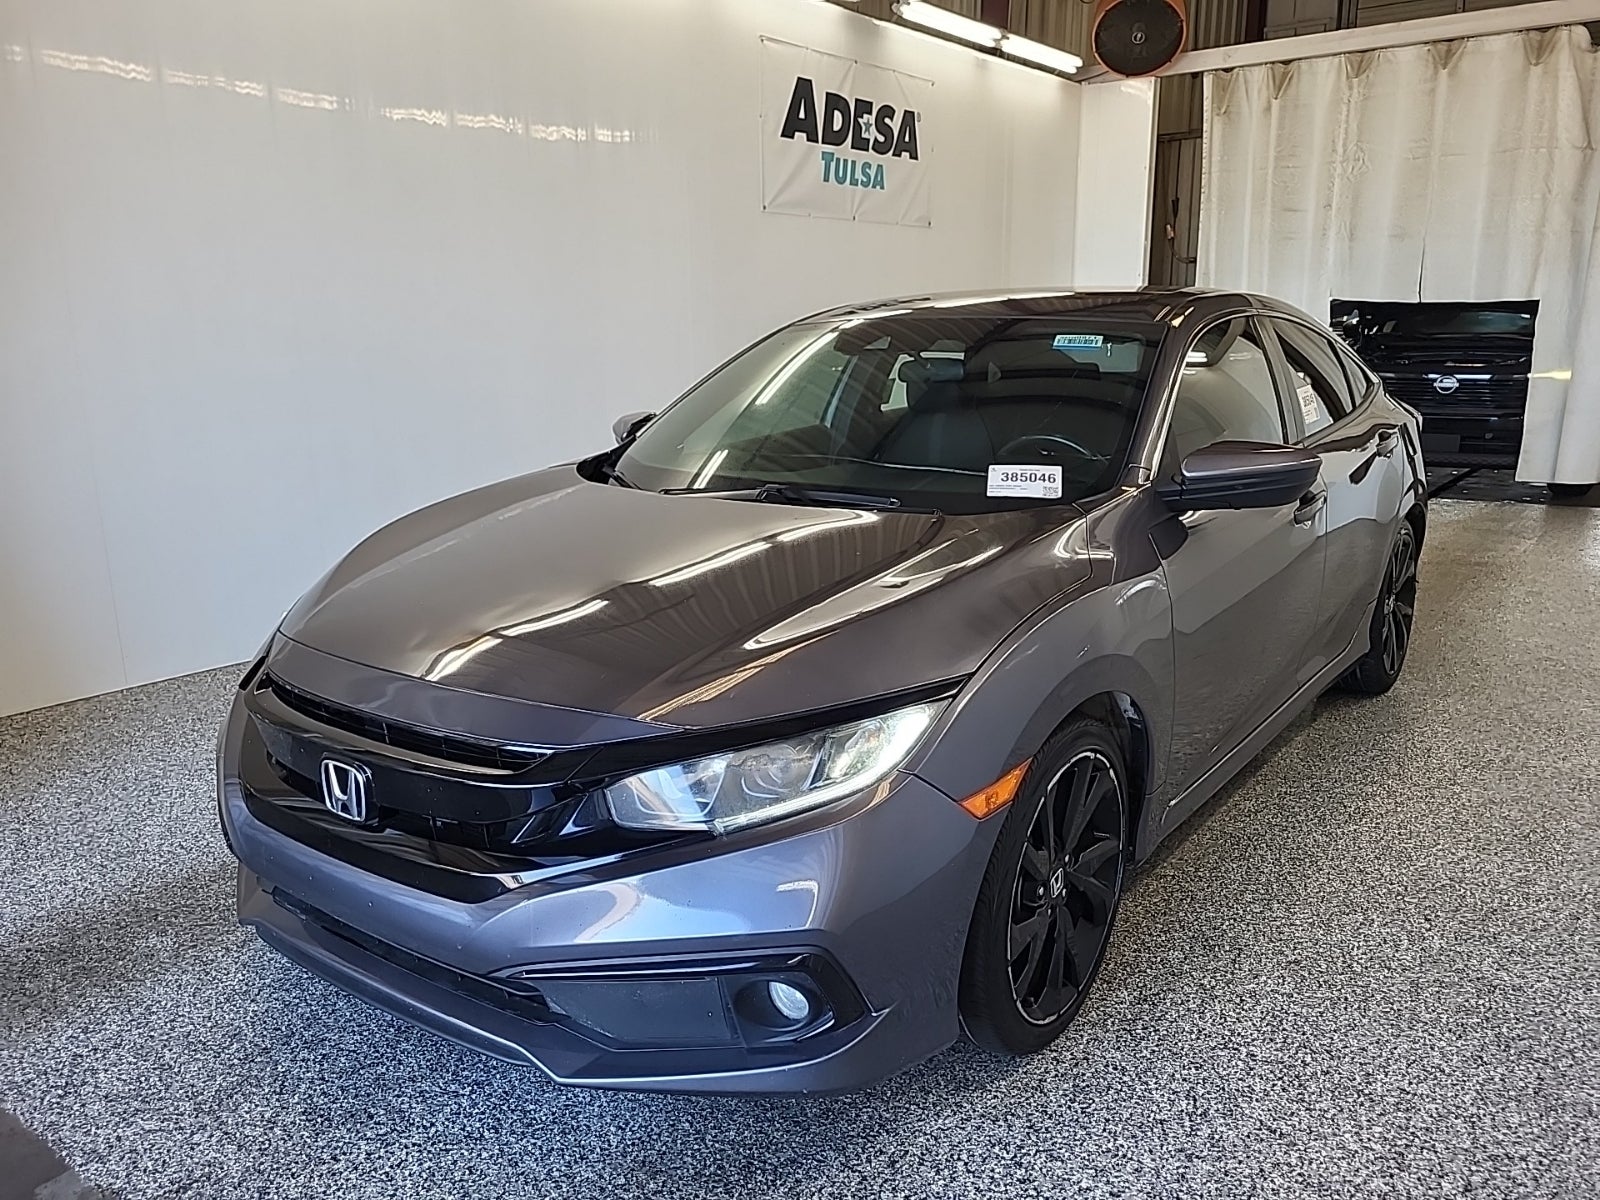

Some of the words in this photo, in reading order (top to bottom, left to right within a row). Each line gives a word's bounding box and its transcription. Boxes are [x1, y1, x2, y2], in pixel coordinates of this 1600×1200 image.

[780, 76, 919, 161] ADESA
[821, 150, 885, 190] TULSA
[1000, 471, 1057, 484] 385046
